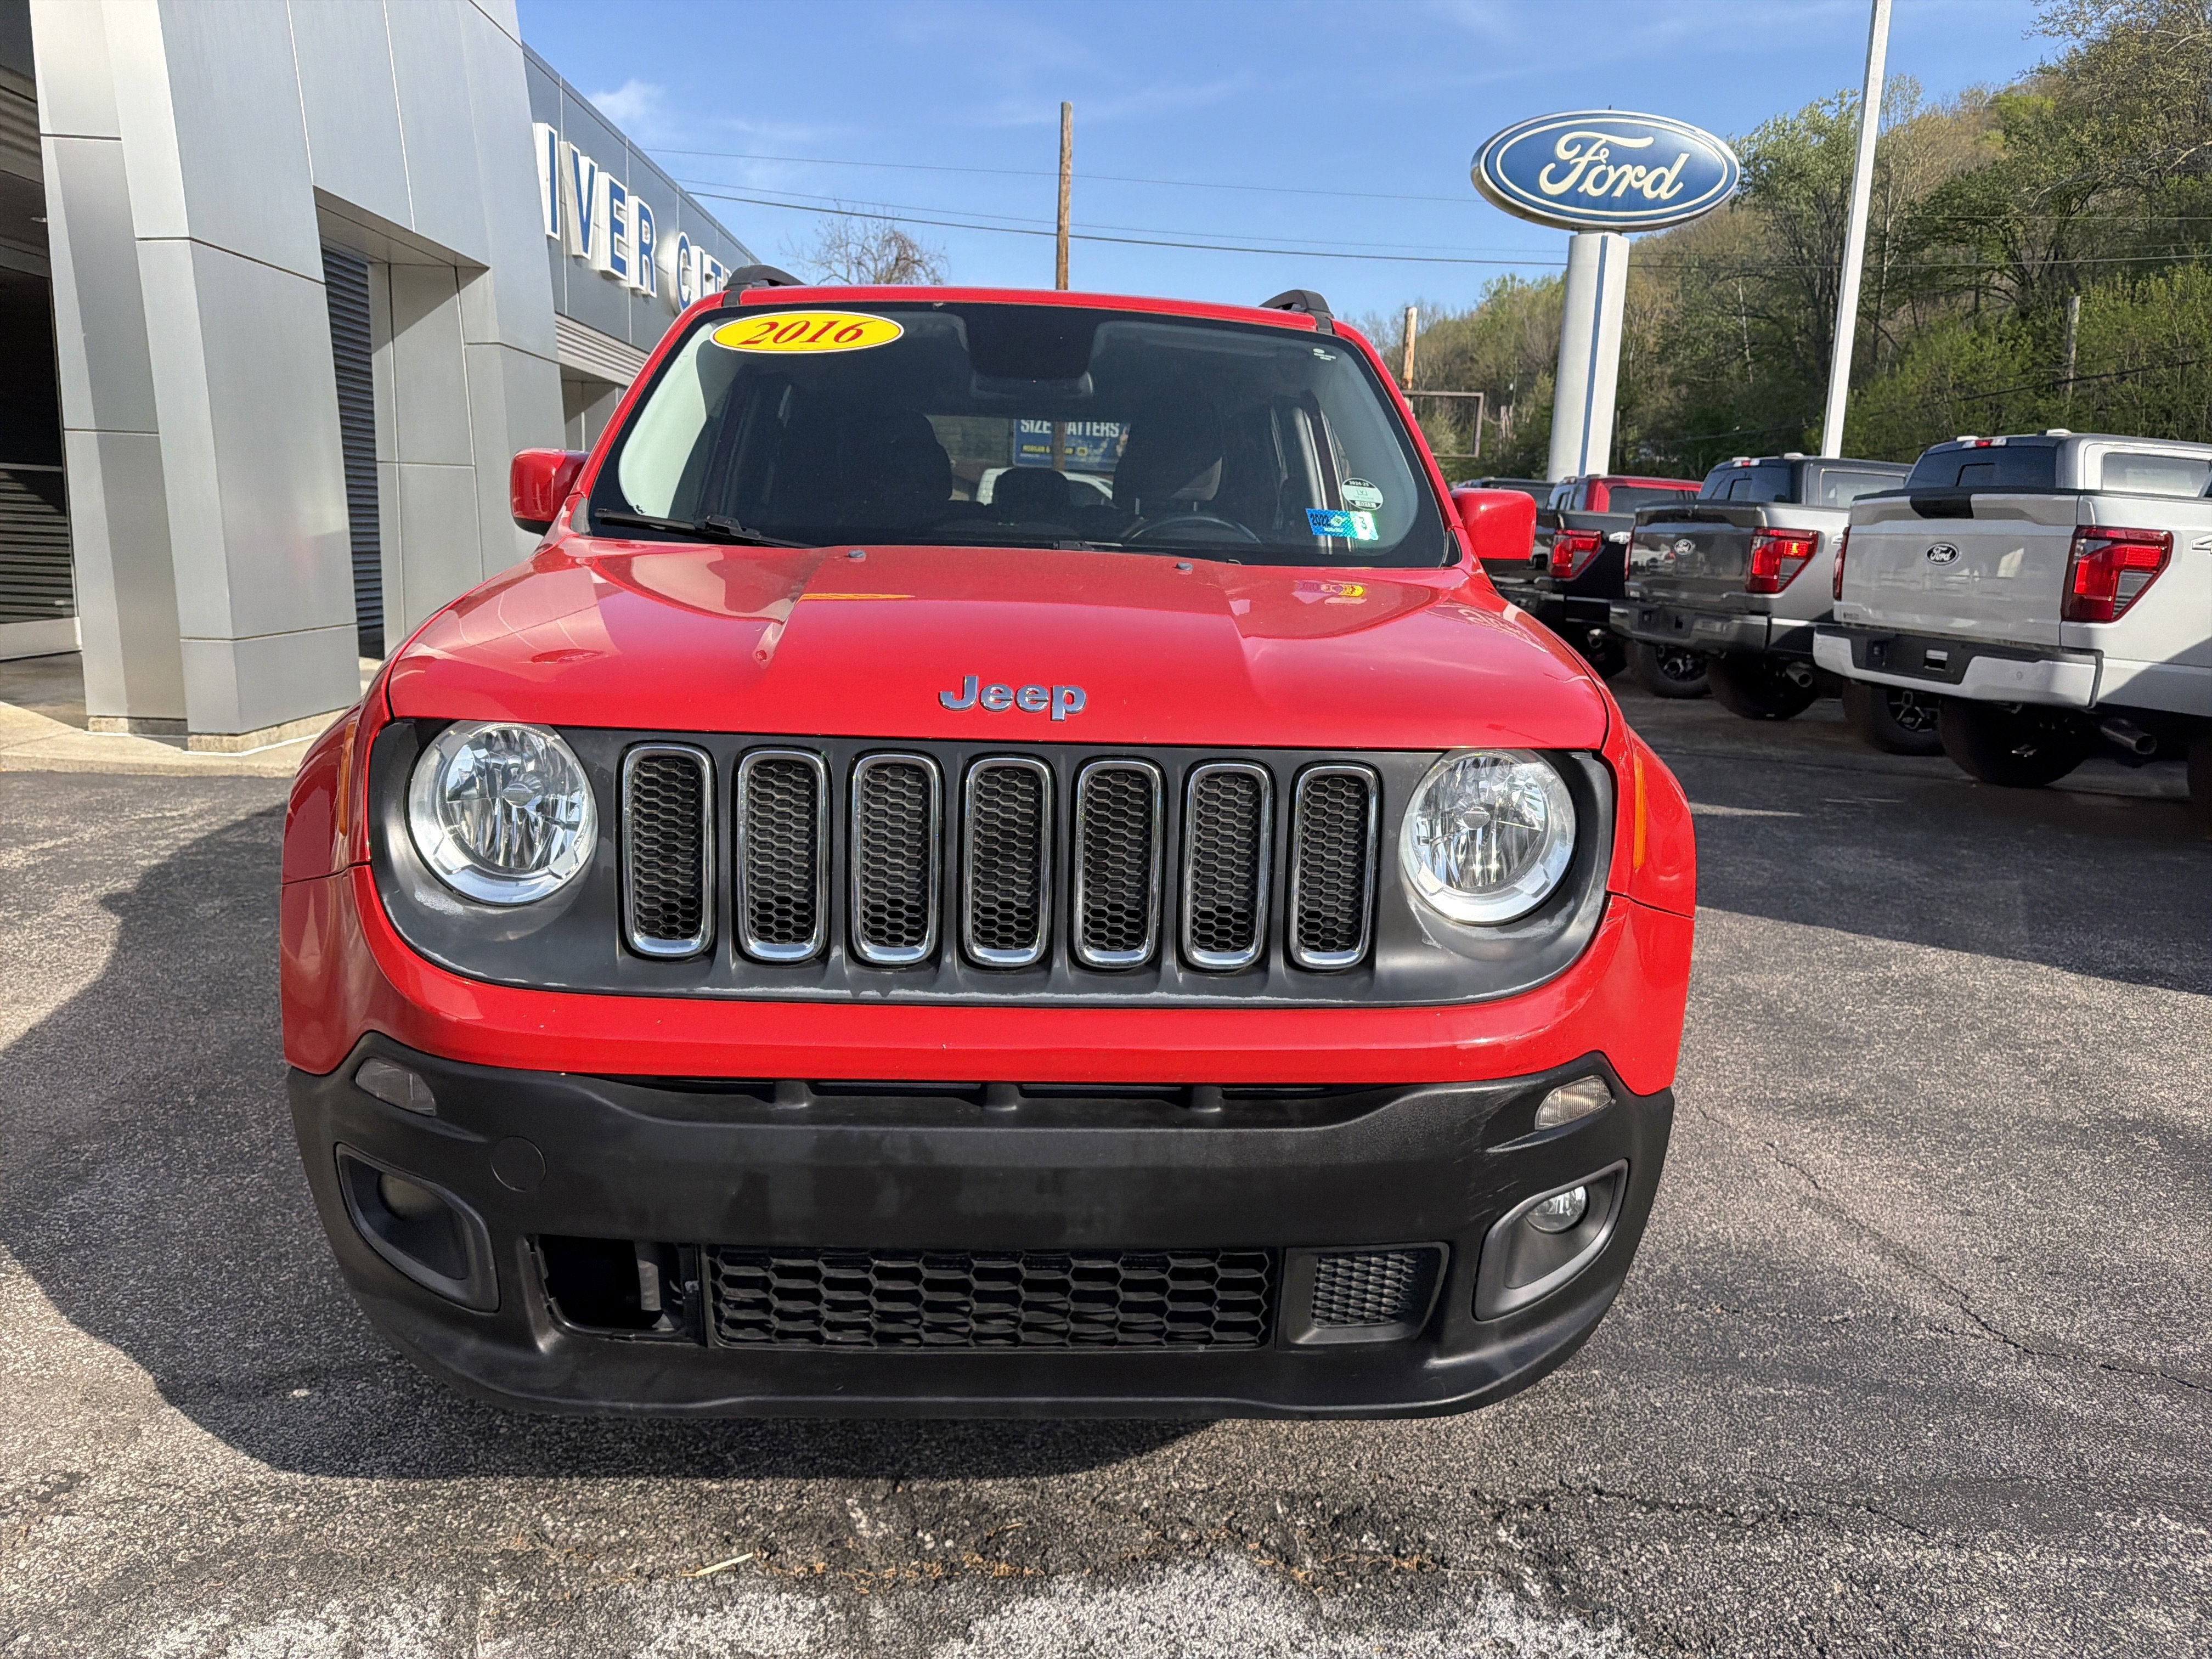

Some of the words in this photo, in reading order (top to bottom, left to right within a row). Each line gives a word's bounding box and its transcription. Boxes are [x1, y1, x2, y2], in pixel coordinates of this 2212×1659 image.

[1539, 131, 1689, 200] Ford
[670, 232, 731, 312] CIT
[737, 320, 876, 346] 2016
[1020, 419, 1051, 434] SIZE
[1065, 421, 1120, 437] ATTERS
[1929, 545, 1953, 561] Ford
[938, 675, 1086, 722] Jeep
